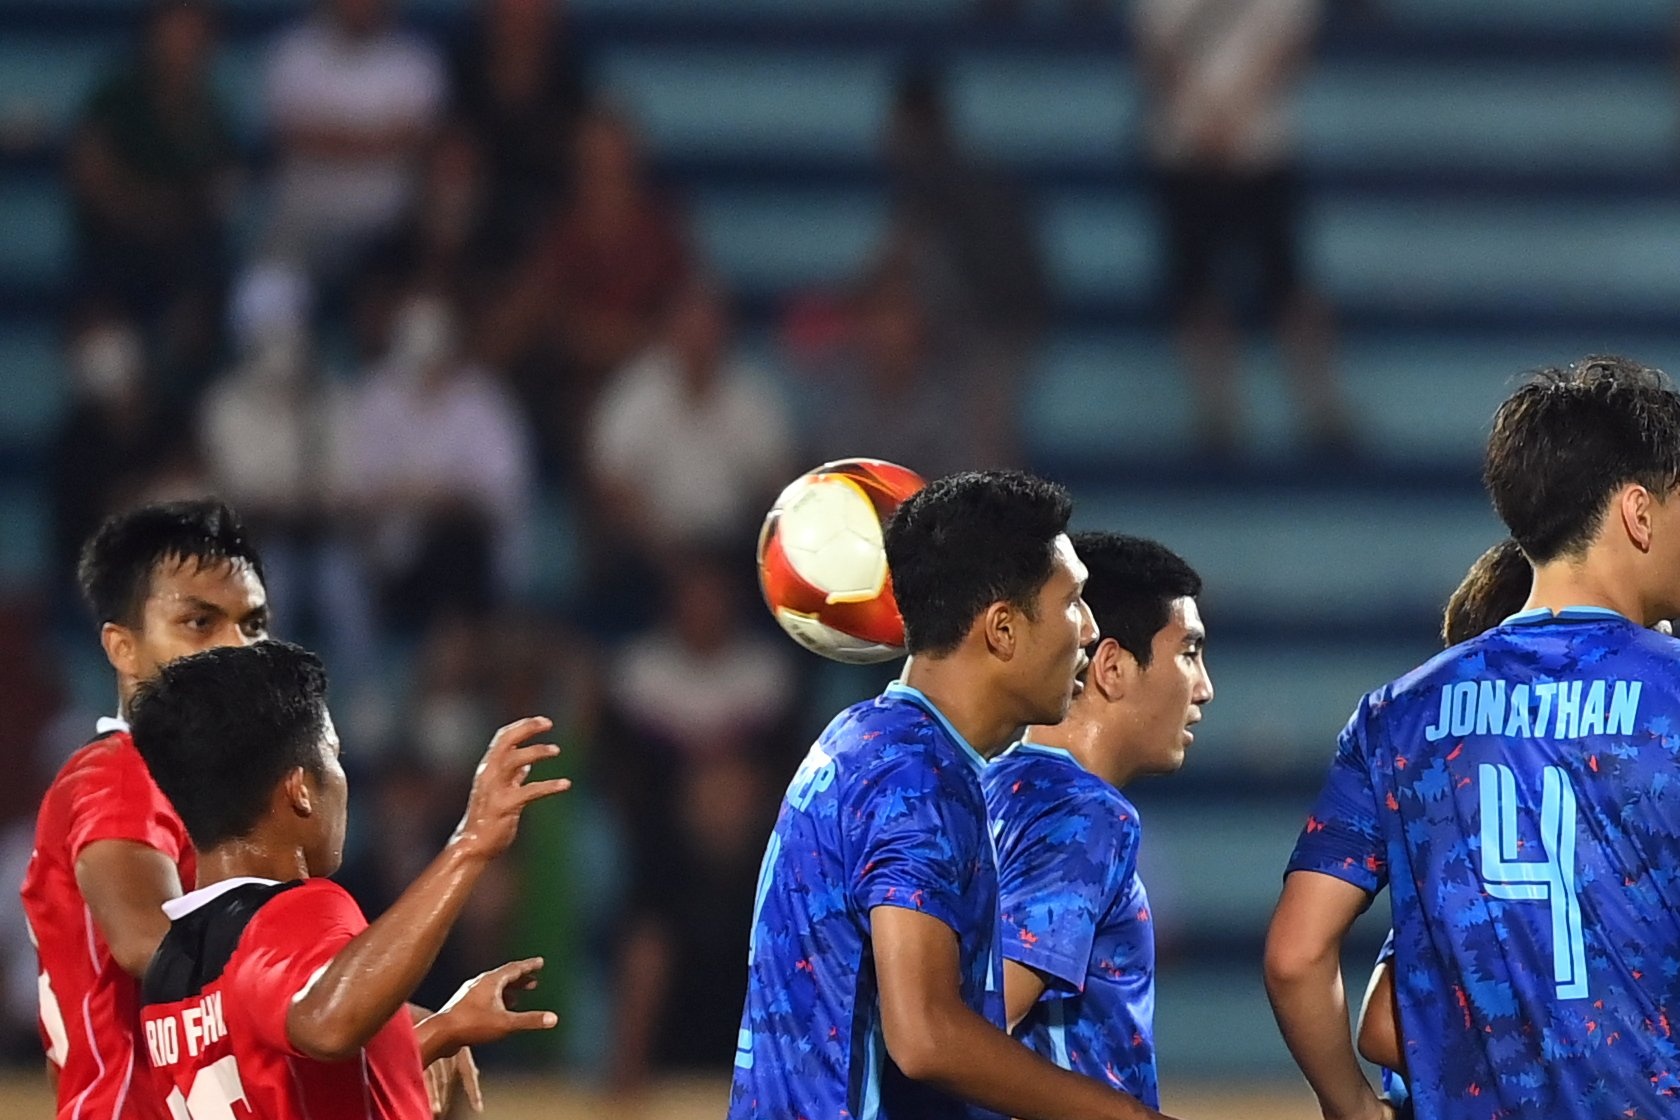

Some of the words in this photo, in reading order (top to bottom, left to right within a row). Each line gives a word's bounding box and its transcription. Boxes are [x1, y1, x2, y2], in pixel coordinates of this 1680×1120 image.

[1425, 679, 1642, 742] JONATHAN
[1478, 763, 1589, 1000] 4
[145, 1016, 179, 1068] RIO
